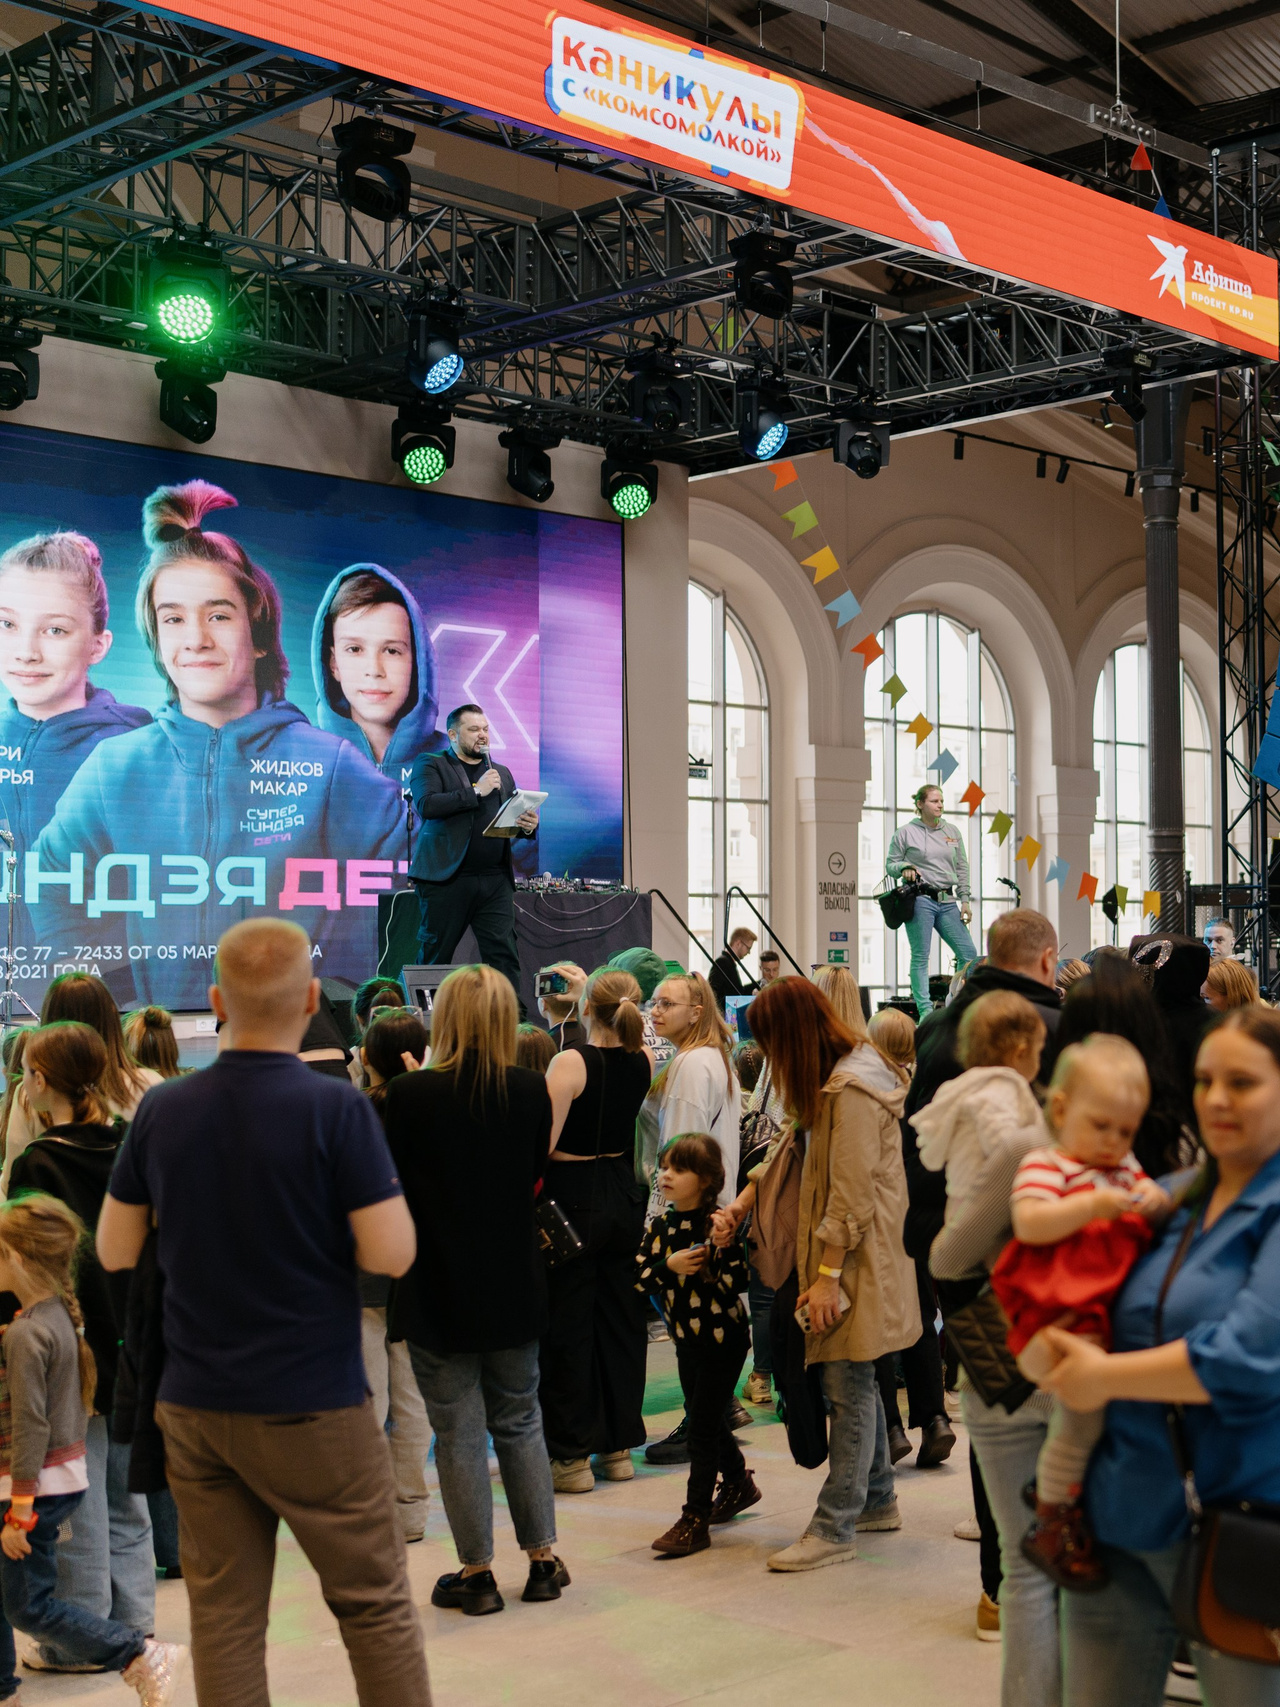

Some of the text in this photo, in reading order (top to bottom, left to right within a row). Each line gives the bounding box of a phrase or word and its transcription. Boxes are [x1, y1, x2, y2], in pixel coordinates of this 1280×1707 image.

[1191, 260, 1253, 299] Афиша
[1191, 291, 1227, 310] ПРОЕКТ
[250, 758, 324, 778] ЖИДКОВ
[0, 769, 34, 785] РЬЯ
[250, 779, 308, 796] МАКАР
[246, 803, 298, 820] СУПЕР
[278, 857, 413, 911] ДЕ
[819, 881, 856, 896] ЗАПАСНЫЙ
[825, 896, 851, 912] ВЫХОД
[33, 946, 52, 961] 77
[74, 945, 123, 960] 72433
[128, 945, 152, 960] ОТ
[157, 945, 178, 960] 05
[182, 945, 219, 960] МАР
